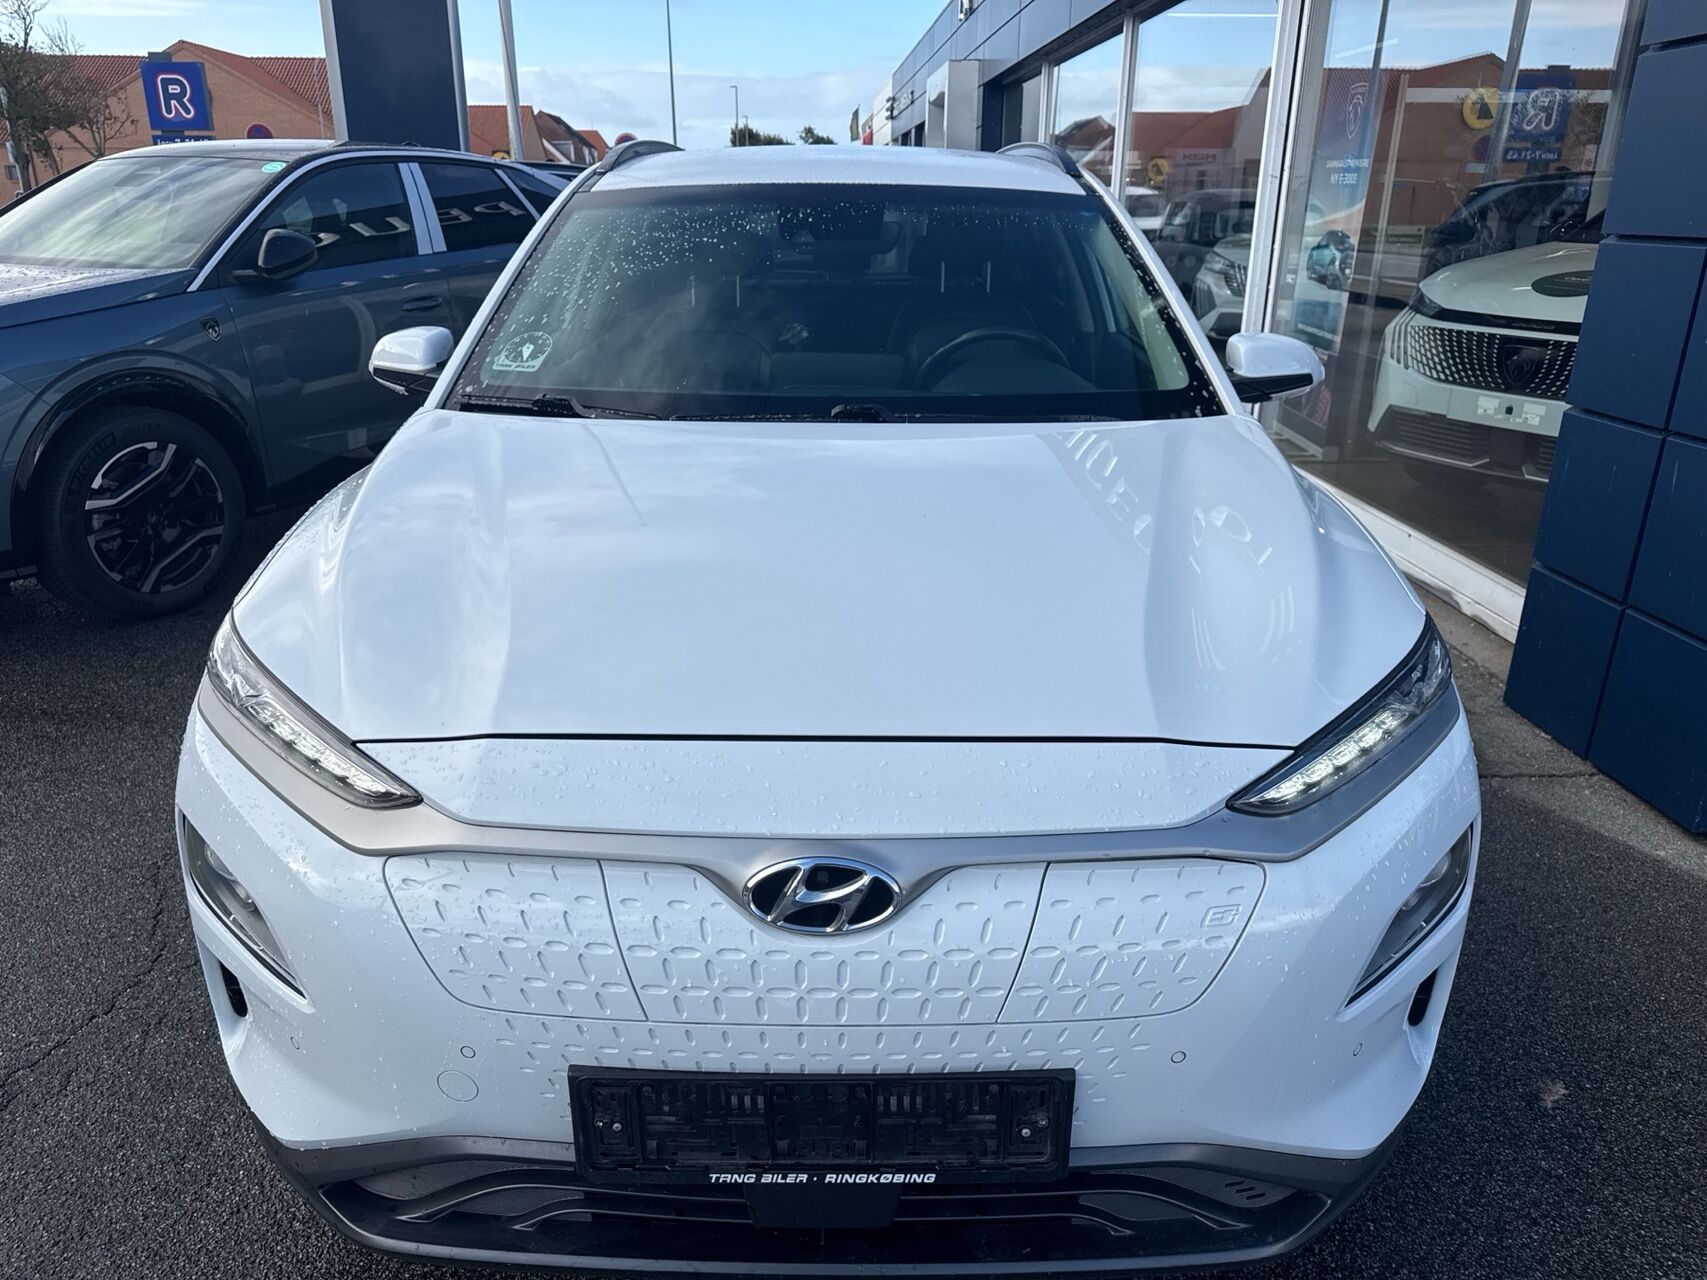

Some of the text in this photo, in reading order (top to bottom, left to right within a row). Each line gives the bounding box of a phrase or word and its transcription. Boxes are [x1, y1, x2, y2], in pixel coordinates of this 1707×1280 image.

[157, 72, 194, 120] R
[709, 1173, 937, 1184] TANG BILER RINGKØBING
